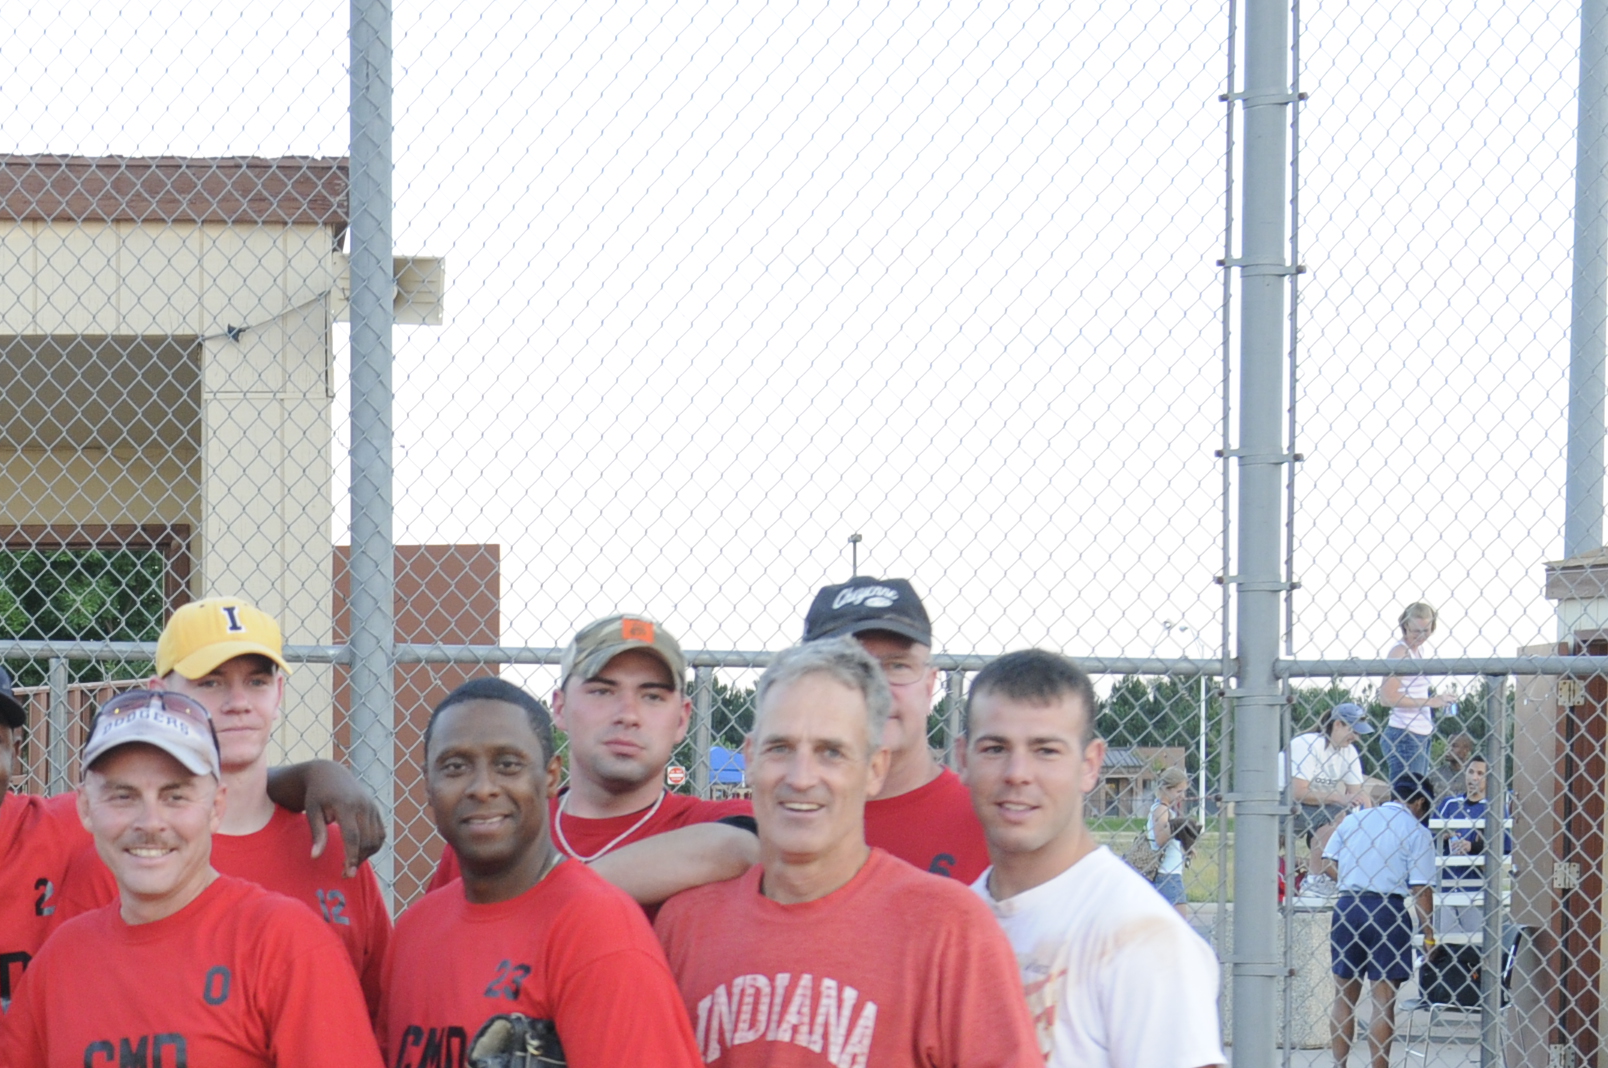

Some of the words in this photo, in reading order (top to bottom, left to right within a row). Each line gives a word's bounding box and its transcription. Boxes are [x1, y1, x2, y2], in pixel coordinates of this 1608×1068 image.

[221, 605, 244, 632] I
[101, 706, 190, 736] DODGERS
[34, 877, 56, 917] 2
[315, 888, 351, 926] 12
[483, 959, 532, 1000] 23
